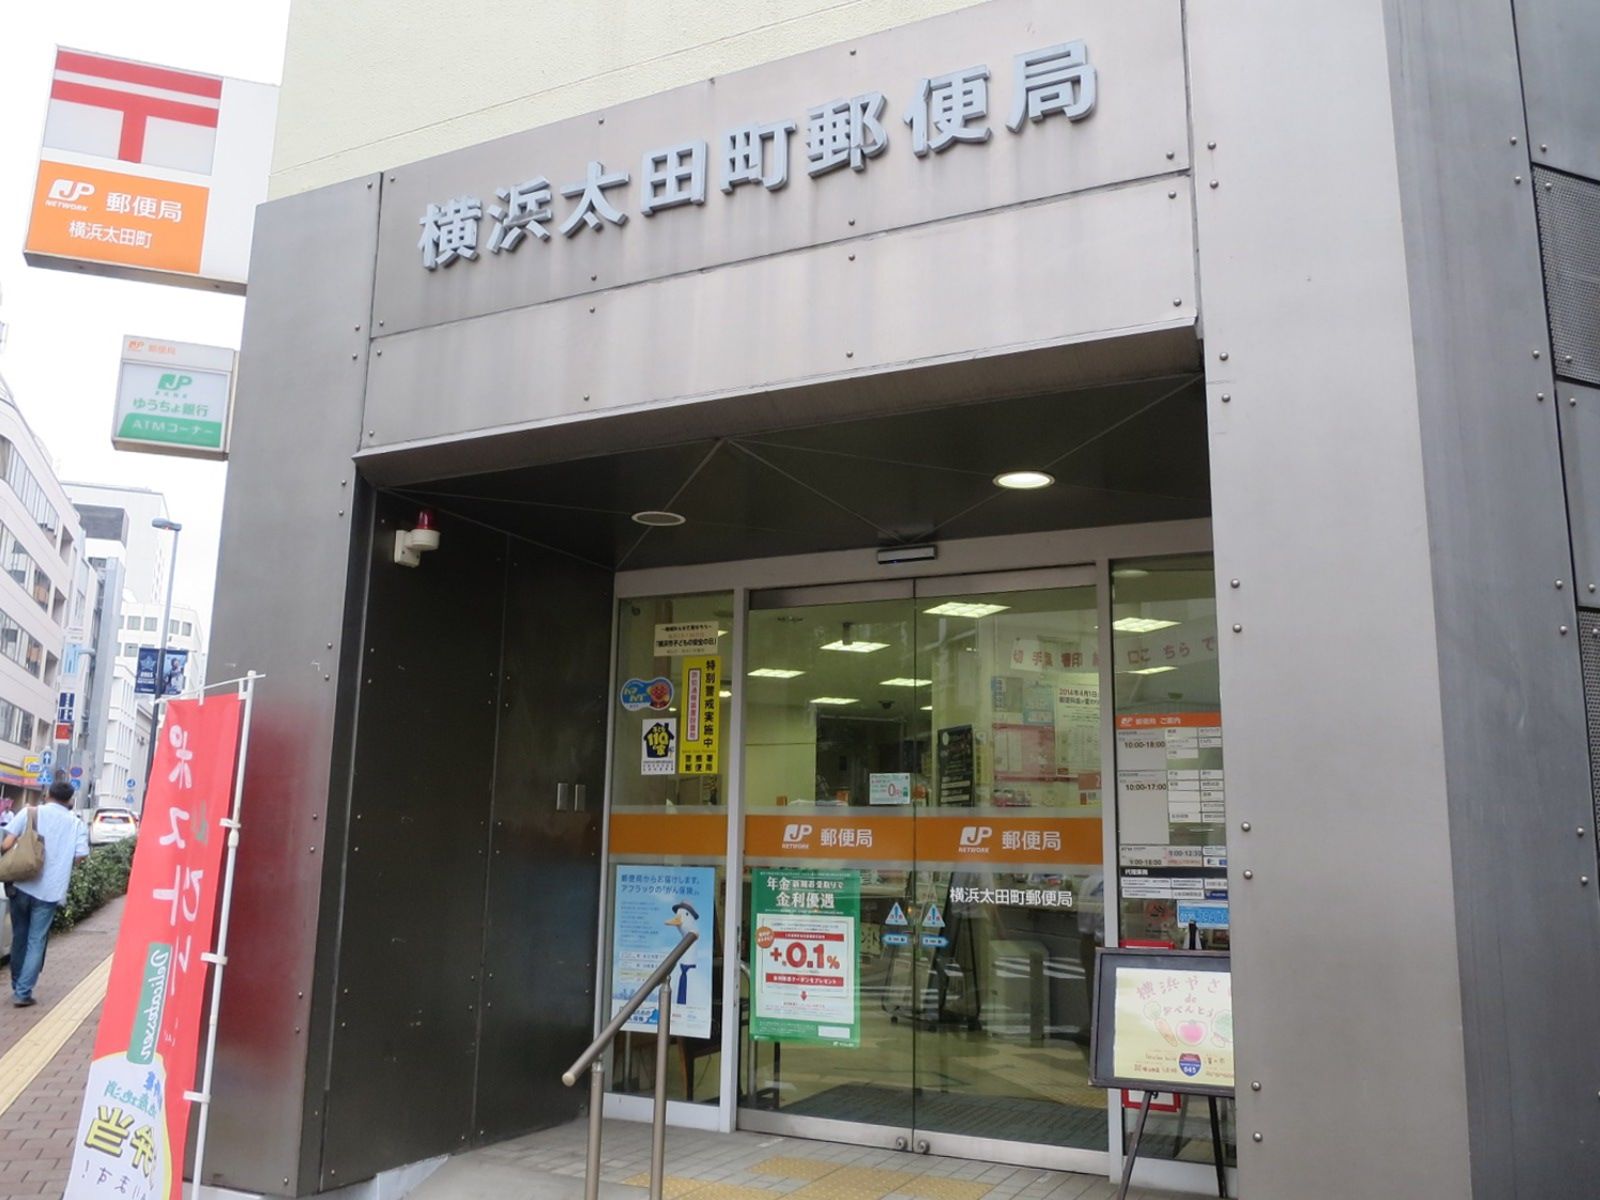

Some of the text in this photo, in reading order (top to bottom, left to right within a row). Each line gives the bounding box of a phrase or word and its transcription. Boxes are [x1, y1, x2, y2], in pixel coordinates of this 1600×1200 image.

[418, 39, 1098, 270] 横浜太田町郵便局
[45, 200, 89, 213] NETWORK
[106, 192, 183, 223] 郵便局
[69, 220, 153, 249] 横浜太田町
[133, 398, 209, 418] ゆうちょ銀行
[132, 420, 214, 437] ATMコーナー
[703, 660, 716, 748] 特別警戒実施中
[647, 732, 669, 746] 110
[820, 828, 873, 849] 郵便局
[1002, 830, 1062, 852] 郵便局
[958, 846, 990, 855] NETWORK
[776, 891, 835, 909] 金利優遇
[950, 887, 1073, 908] 横浜太田町郵便局
[1136, 976, 1232, 1000] 横浜やさ
